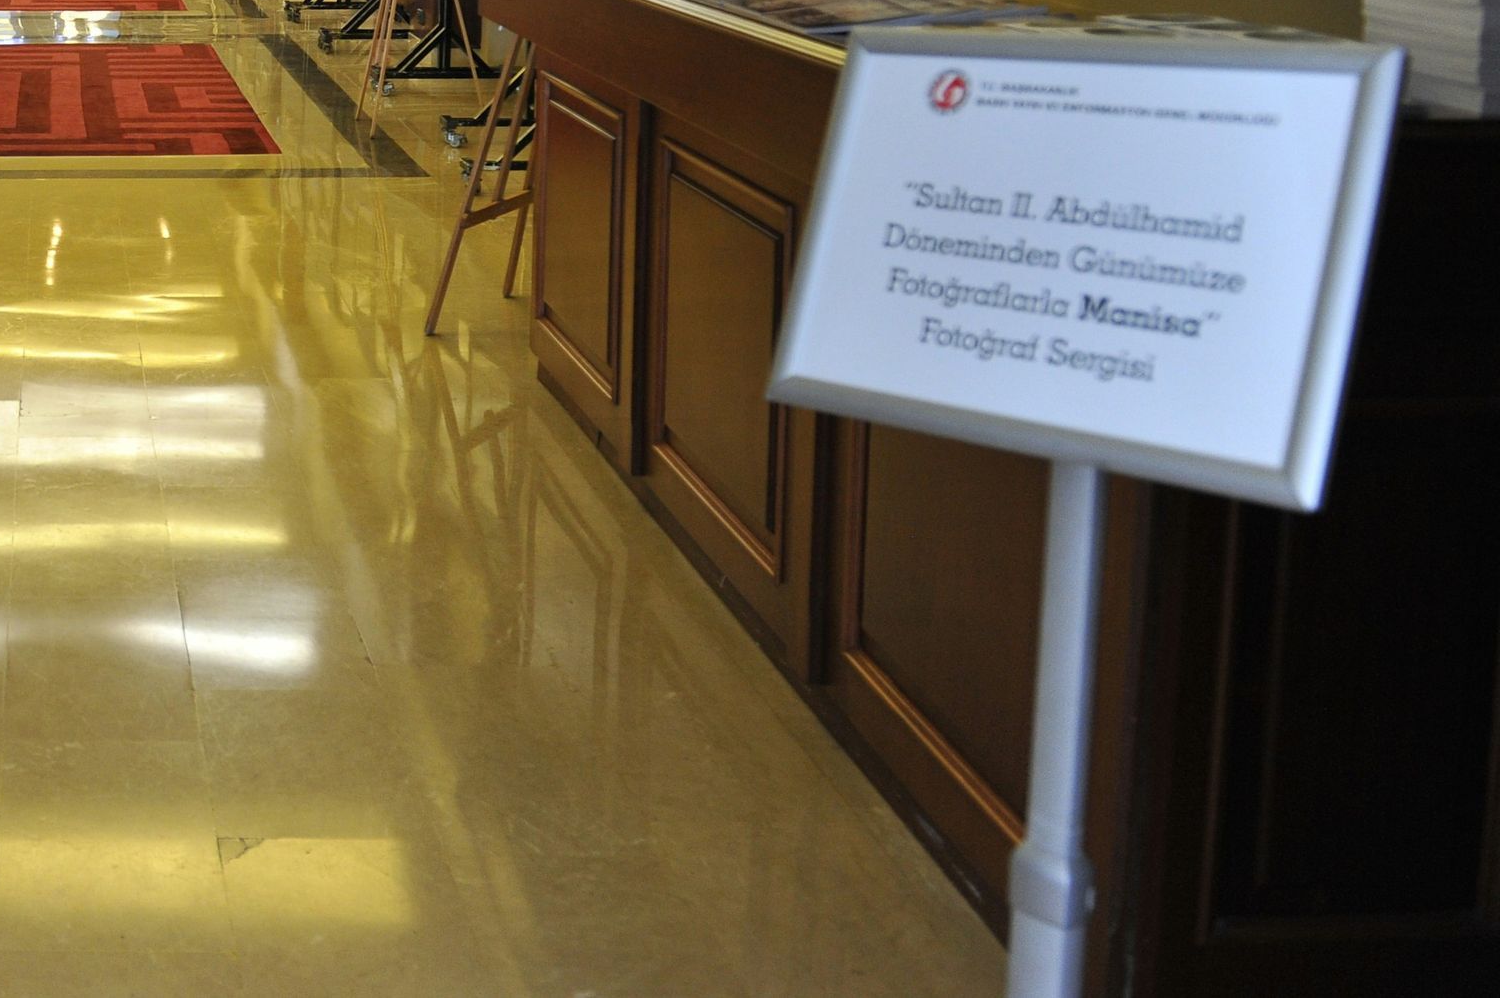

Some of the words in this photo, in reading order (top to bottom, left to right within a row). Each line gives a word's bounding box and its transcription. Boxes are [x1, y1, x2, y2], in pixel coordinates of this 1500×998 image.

[1045, 196, 1245, 242] Abdülhamid
[883, 222, 1060, 269] Döneminden
[1071, 245, 1247, 293] Günümüze
[887, 267, 1069, 317] Fotoğraflarla
[920, 316, 1040, 361] Fotoğraf
[1048, 338, 1154, 382] Sergisi
